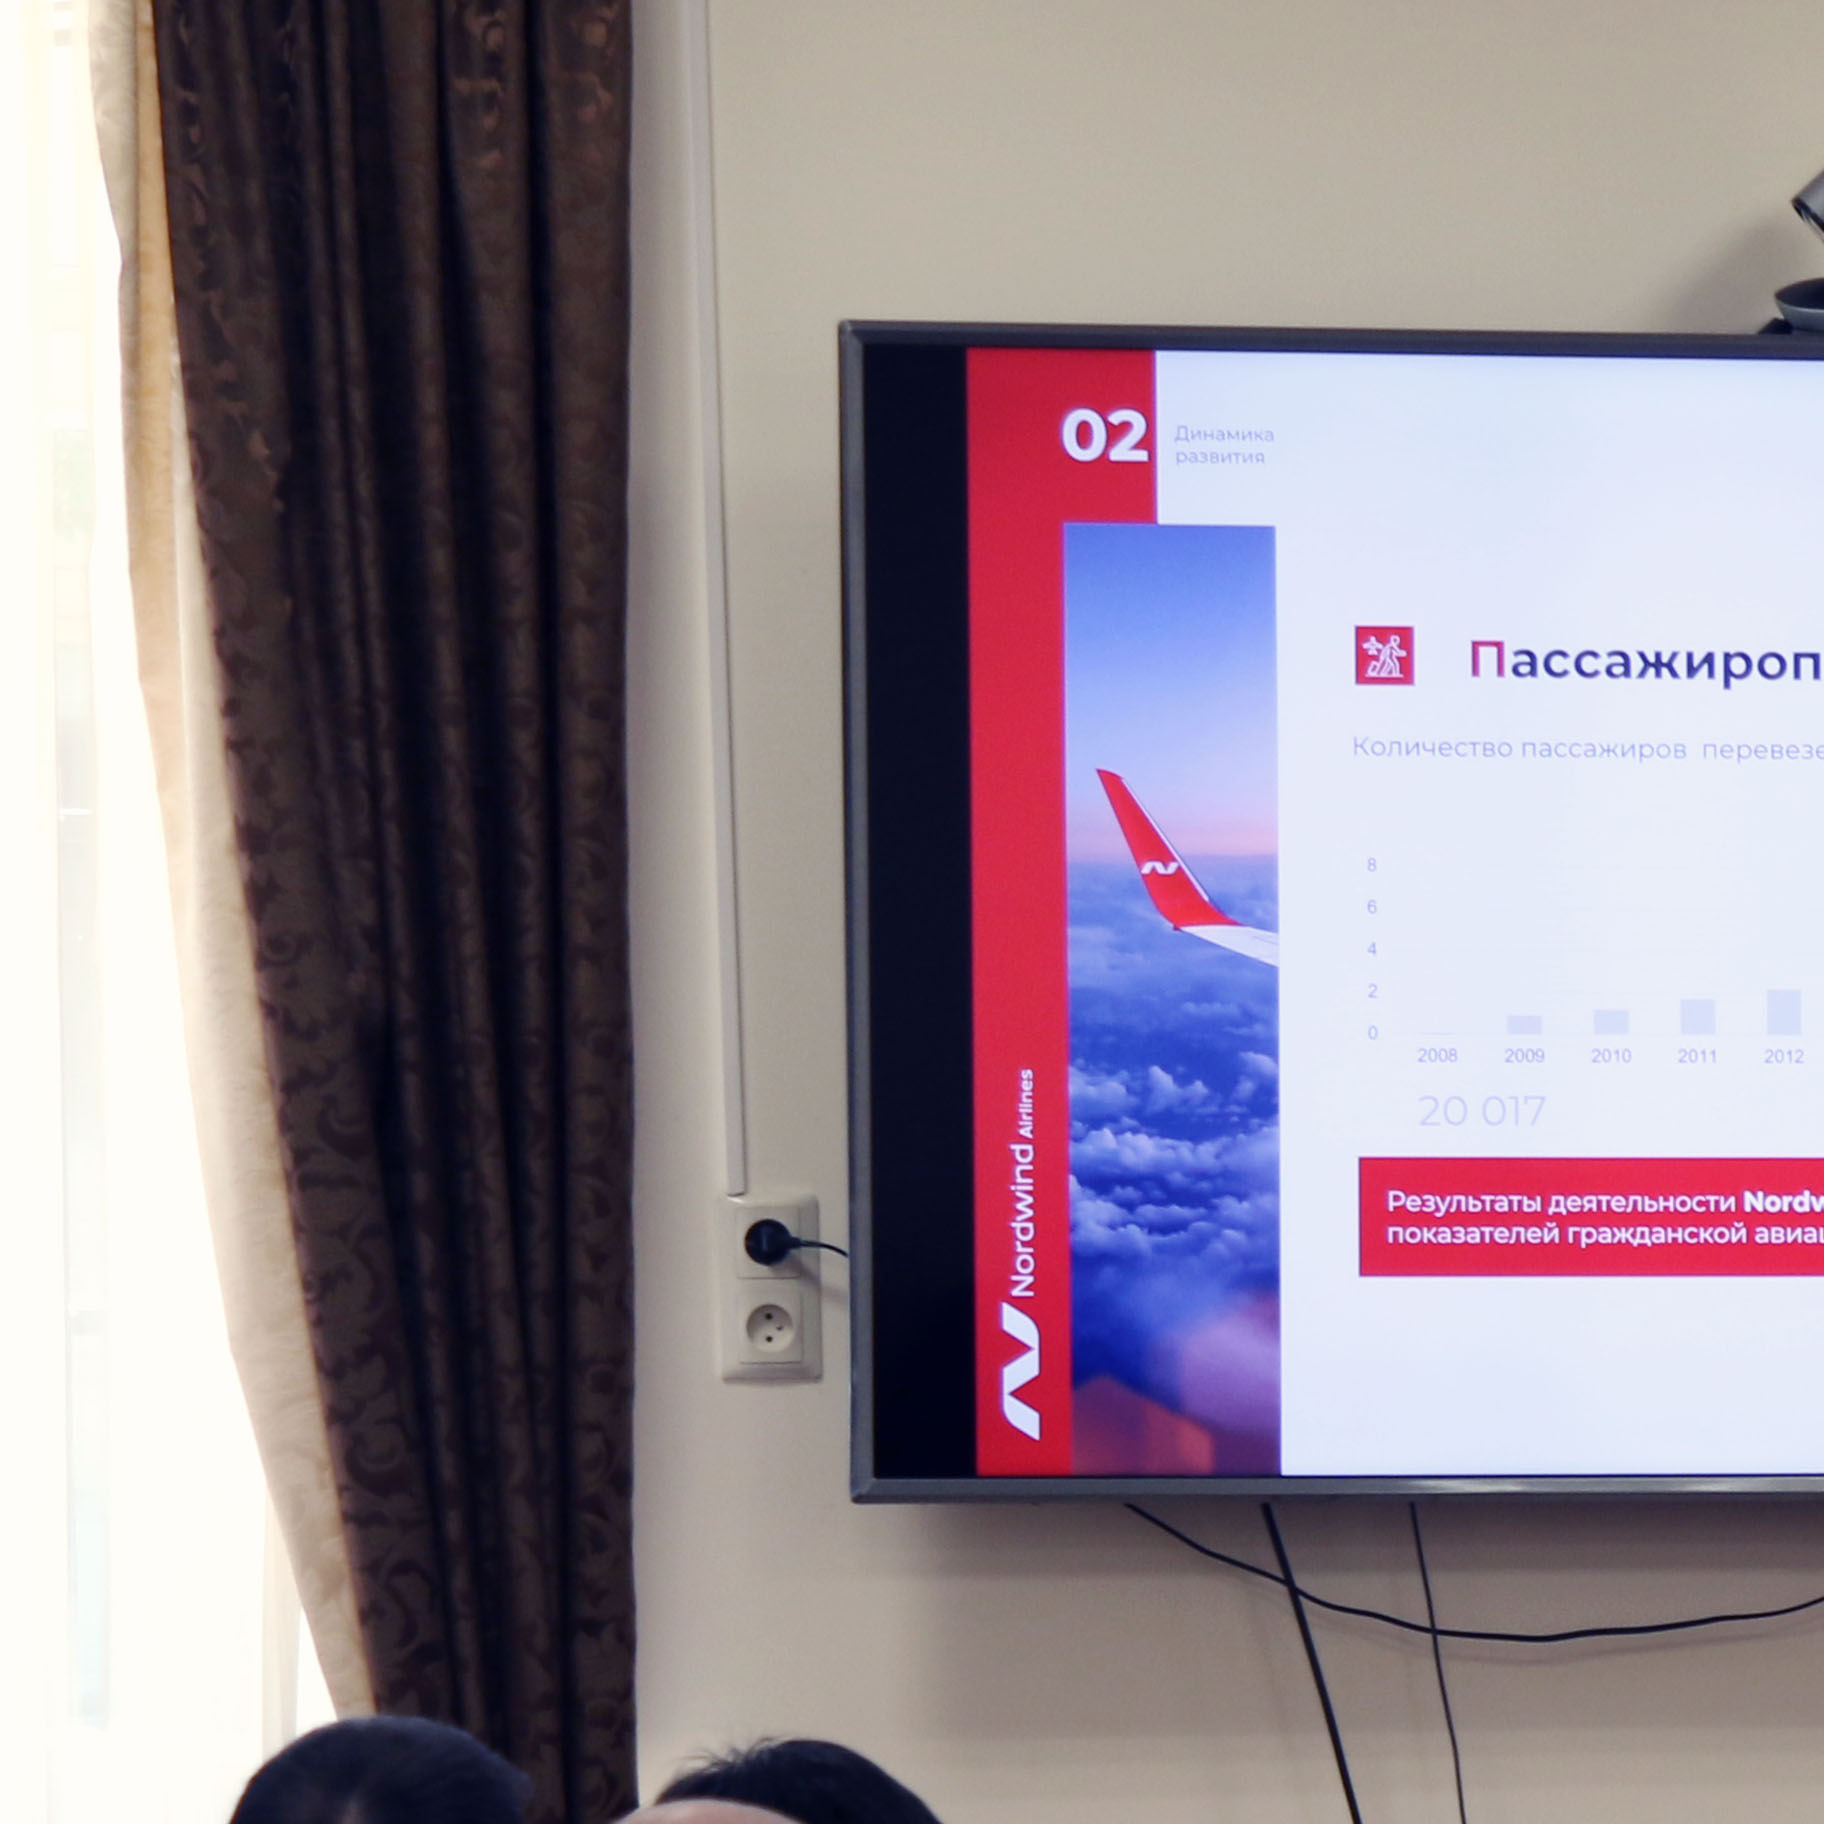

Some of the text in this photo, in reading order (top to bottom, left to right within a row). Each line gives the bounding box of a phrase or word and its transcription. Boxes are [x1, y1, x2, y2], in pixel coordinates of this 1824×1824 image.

[1061, 407, 1149, 462] 02
[1174, 424, 1275, 444] Динамика
[1175, 450, 1265, 467] развития
[1352, 735, 1514, 759] Количество
[1521, 740, 1688, 764] пассажиров
[1366, 856, 1378, 873] 8
[1366, 898, 1378, 915] 6
[1366, 941, 1378, 957] 4
[1367, 982, 1379, 999] 2
[1416, 1047, 1459, 1064] 2008
[1503, 1047, 1546, 1065] 2009
[1591, 1047, 1633, 1064] 2010
[1677, 1047, 1717, 1065] 2011
[1763, 1048, 1805, 1065] 2012
[1418, 1095, 1547, 1127] 20 017
[1010, 1068, 1035, 1298] Nordwind Airlines
[1387, 1190, 1542, 1218] Результаты
[1547, 1194, 1737, 1217] деятельности
[1387, 1222, 1561, 1245] показателей
[1567, 1222, 1747, 1248] гражданской
